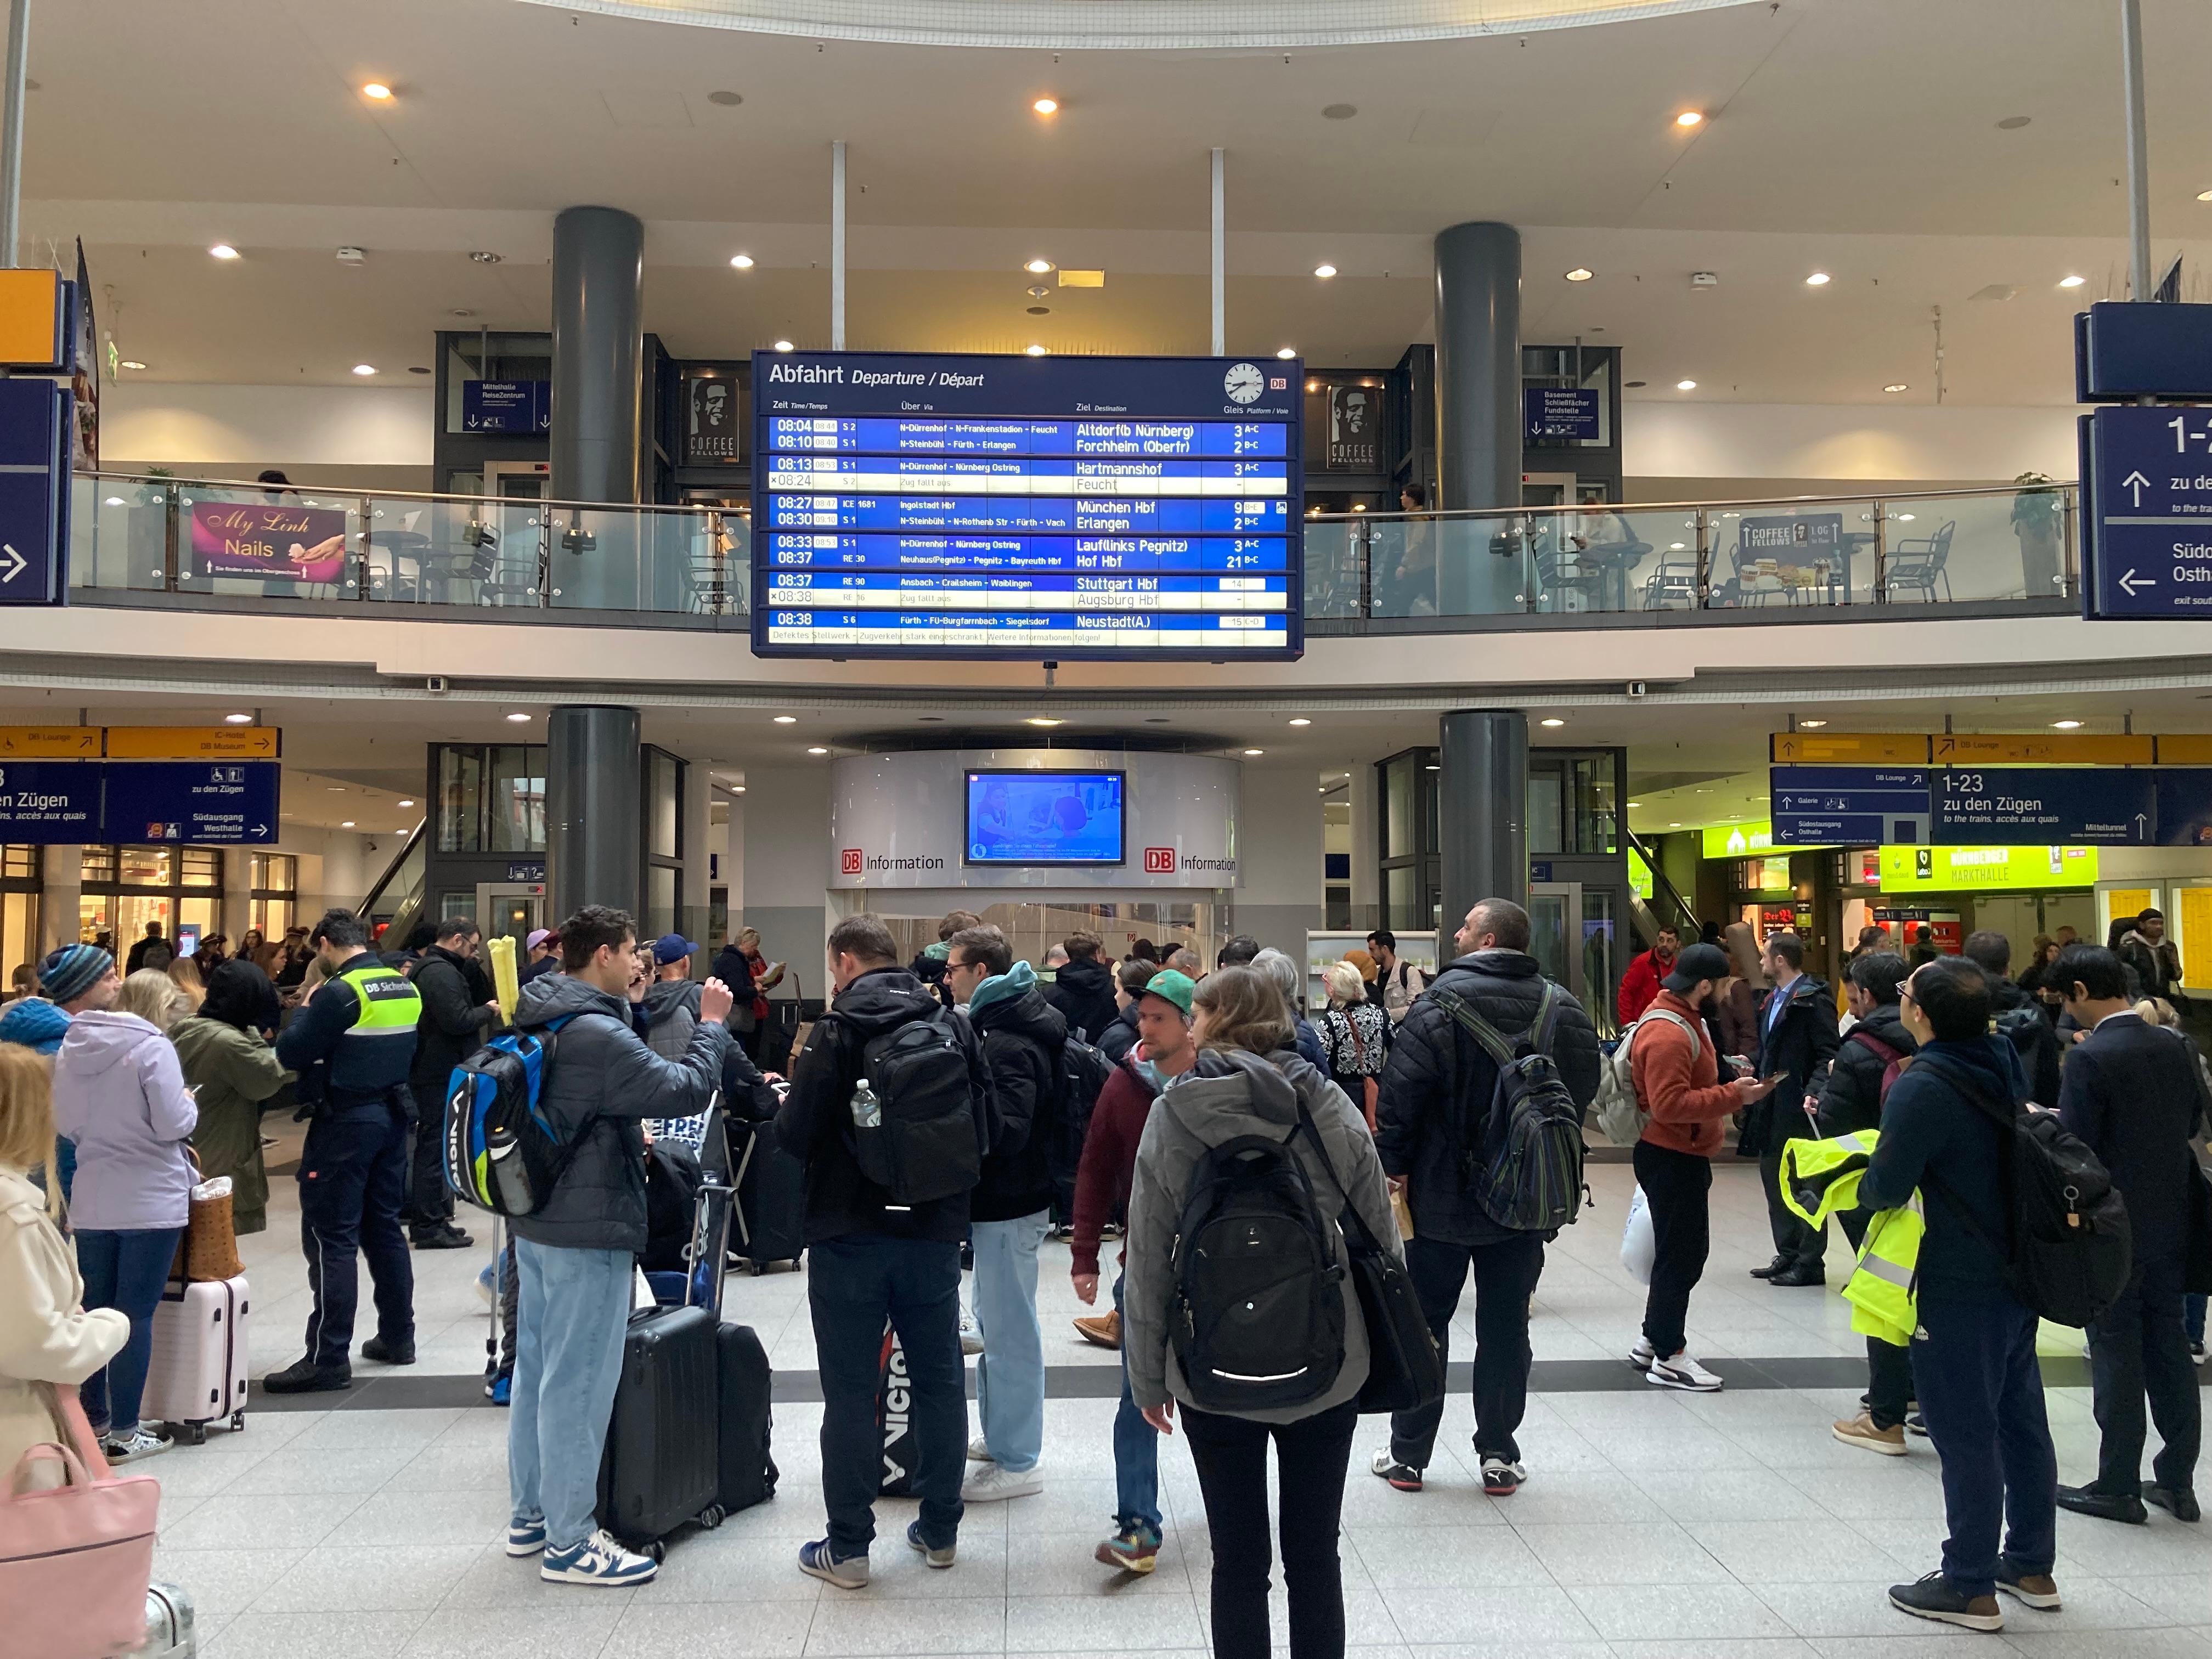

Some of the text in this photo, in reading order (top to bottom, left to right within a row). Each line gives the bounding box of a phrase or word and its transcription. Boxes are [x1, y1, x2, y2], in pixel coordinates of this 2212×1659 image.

[769, 364, 984, 388] Abfahrt Departure Départ
[773, 400, 788, 409] Zeit
[901, 400, 921, 410] Über
[1076, 403, 1091, 411] Ziel
[778, 419, 812, 432] 08:04
[956, 425, 1023, 433] N-Frankenstadion
[1031, 425, 1058, 433] Feucht
[1077, 424, 1132, 437] Altdorf(b
[1136, 424, 1194, 439] Nürnberg)
[1244, 425, 1259, 433] A-C
[691, 437, 733, 450] COFFEE
[778, 435, 812, 448] 08:10
[983, 441, 1016, 450] Erlangen
[1077, 440, 1139, 453] Forchheim
[1143, 441, 1189, 454] (Oberfr)
[1332, 444, 1373, 458] COFFEE
[778, 458, 1259, 475] 08:13 N-Dürrenhof Nürnberg Ostring Hartmannshof A-C
[778, 475, 811, 486] 08:24
[900, 478, 915, 487] Zug
[1077, 478, 1117, 490] Feucht
[2170, 477, 2190, 490] zu
[778, 496, 812, 509] 08:27
[900, 501, 940, 510] Ingolstadt
[1077, 500, 1131, 514] München
[1135, 501, 1155, 514] Hbf
[2172, 504, 2197, 512] to the
[207, 510, 310, 536] My Linh
[778, 513, 812, 525] 08:30
[1077, 517, 1130, 532] Erlangen
[1752, 527, 1790, 539] COFFEE
[225, 539, 273, 557] Nails
[778, 535, 812, 548] 08:33
[956, 540, 990, 550] Nürnberg
[992, 541, 1020, 550] Ostring
[1077, 539, 1136, 552] Lauf(links
[1139, 540, 1188, 554] Pegnitz)
[1752, 538, 1790, 547] FELLOWS
[778, 552, 812, 563] 08:37
[900, 556, 966, 565] Neuhaus(Pegnitz)
[974, 557, 1002, 566] Pegnitz
[1011, 557, 1046, 566] Bayreuth
[1077, 555, 1097, 567] Hof
[1102, 555, 1122, 567] Hbf
[1226, 556, 1242, 568] 21
[778, 574, 812, 586] 08:37
[991, 579, 1032, 589] Waiblingen
[1077, 578, 1133, 592] Stuttgart
[1137, 578, 1158, 590] Hbf
[778, 590, 1159, 608] 08:38 Augsburg Hbf
[2174, 596, 2191, 605] exit
[778, 613, 812, 625] 08:38
[1006, 618, 1049, 627] Siegelsdorf
[1077, 616, 1150, 629] Neustadt(A.)
[859, 633, 902, 641] Zugverkehr
[1075, 634, 1101, 643] folgen!
[219, 785, 244, 794] Zügen
[1943, 774, 1983, 793] 1-23
[18, 792, 68, 810] Zügen
[1944, 797, 2041, 814] zu den Zügen
[16, 811, 42, 820] accès
[63, 812, 87, 821] quais
[193, 814, 244, 822] Südausgang
[1944, 815, 1952, 823] to
[1954, 815, 1967, 823] the
[1996, 814, 2019, 823] accès
[2038, 815, 2059, 824] quais
[843, 851, 943, 871] DB Information
[1147, 850, 1235, 871] DB Information
[1951, 847, 2008, 866] NÜRNBERGER
[1952, 867, 2008, 883] MARKTHALLE
[365, 983, 380, 993] DB
